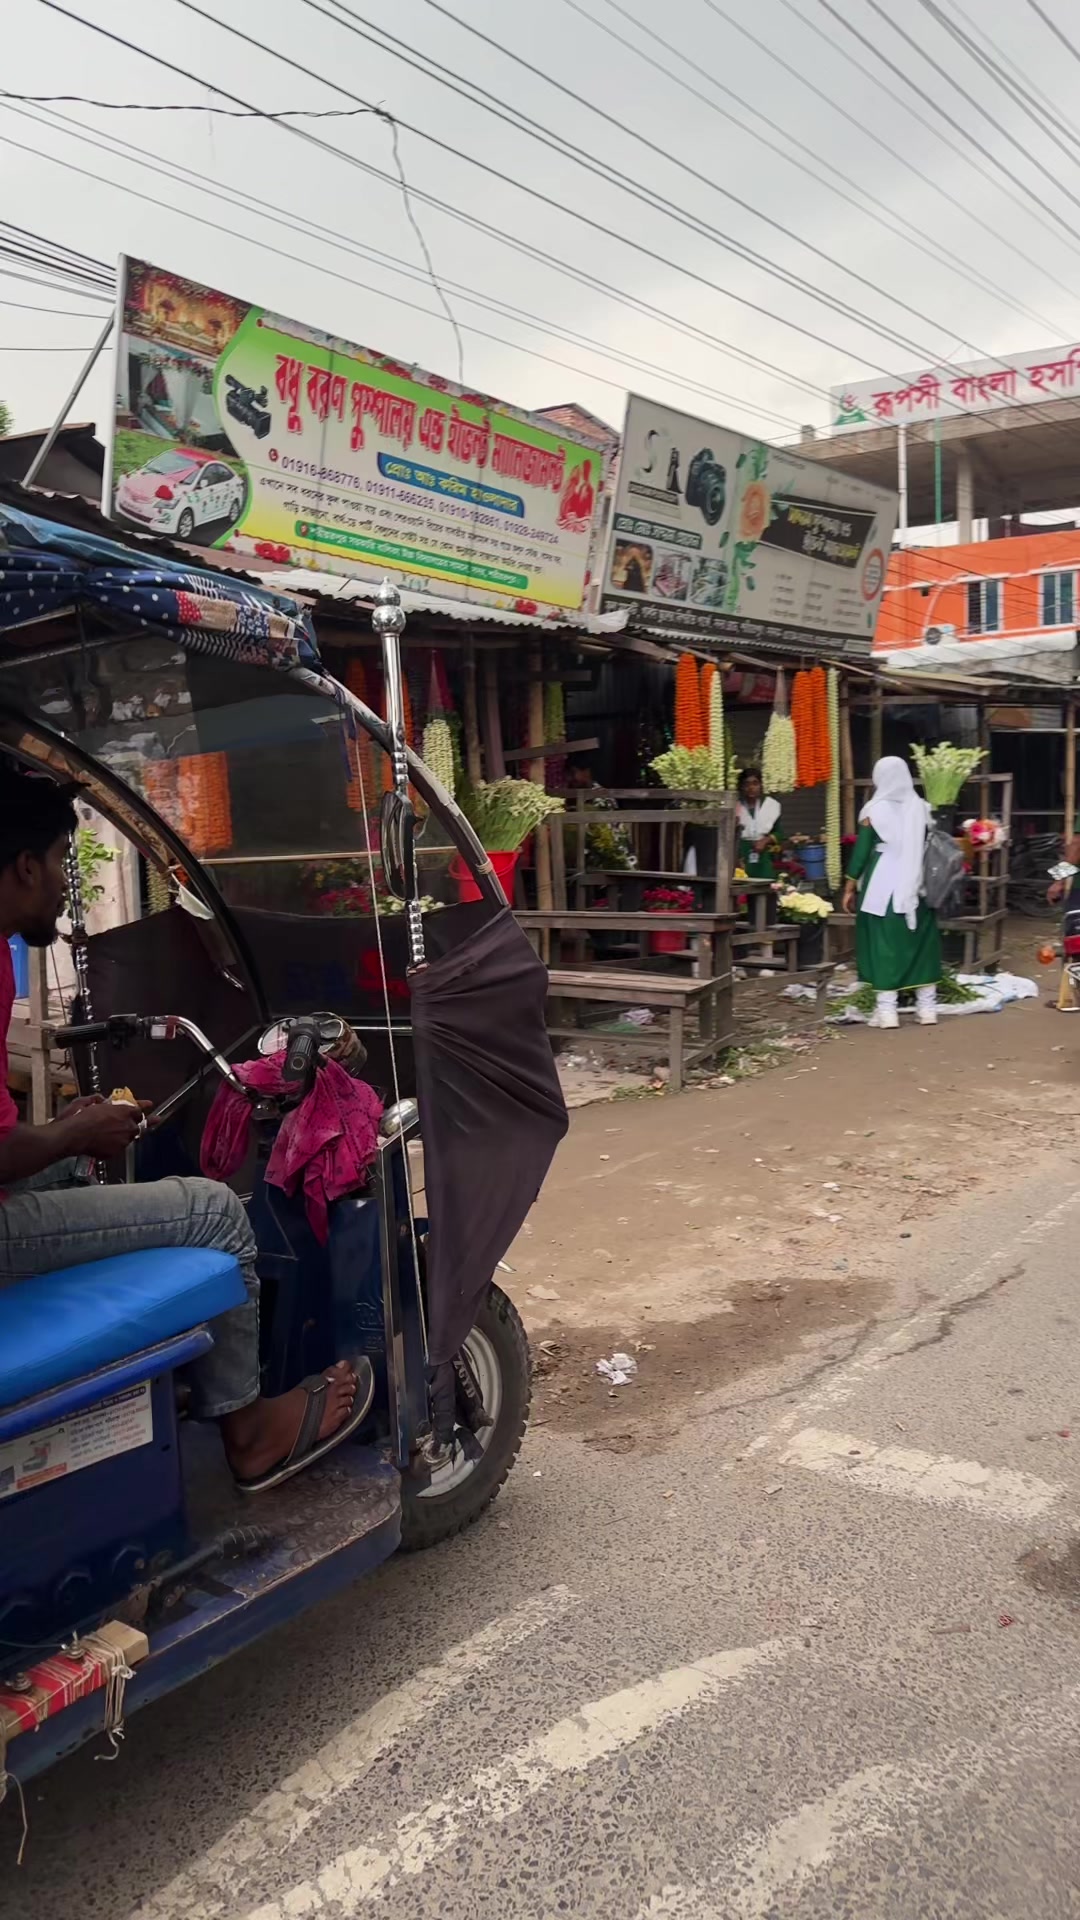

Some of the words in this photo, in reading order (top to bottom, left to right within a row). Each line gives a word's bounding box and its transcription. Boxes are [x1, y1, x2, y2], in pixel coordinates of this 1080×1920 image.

[306, 364, 348, 423] বরণ
[870, 373, 941, 417] রূপসী
[949, 370, 1018, 403] বাংলা
